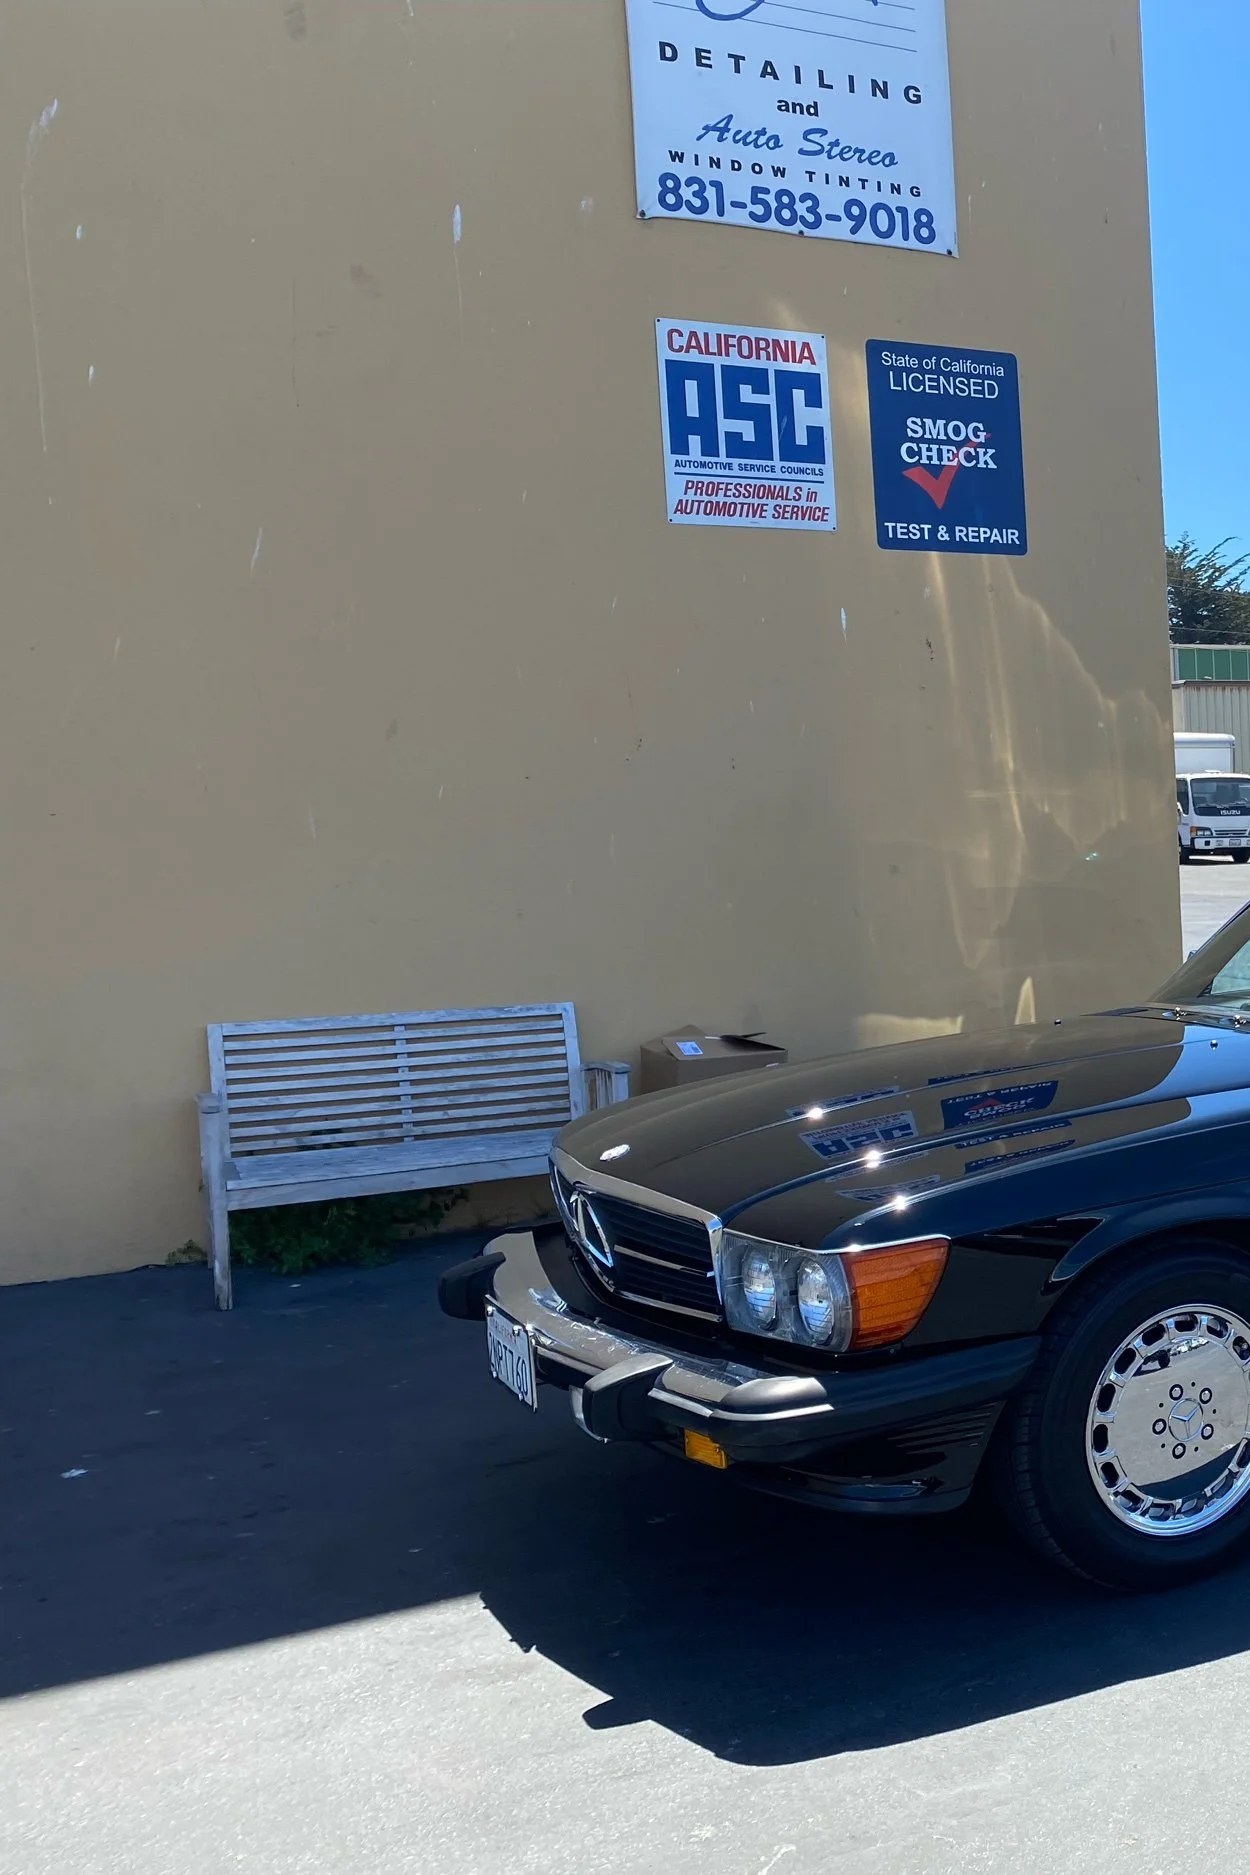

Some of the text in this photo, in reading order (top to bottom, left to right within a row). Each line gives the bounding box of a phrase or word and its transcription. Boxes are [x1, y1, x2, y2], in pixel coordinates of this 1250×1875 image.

[658, 40, 923, 105] DETAILING
[776, 98, 820, 118] and
[695, 113, 899, 168] Auto Stereo
[668, 150, 922, 198] WINDOW TINTING
[657, 171, 937, 245] 831-583-9018
[666, 328, 817, 366] CALIFORNIA
[881, 351, 1005, 377] State of California
[889, 370, 999, 400] LICENSED
[664, 358, 826, 465] ASC
[906, 416, 988, 443] SMOG
[674, 459, 824, 477] AUTOMOTIVE SERVICE COUNCILS
[900, 442, 998, 469] CHECK
[683, 479, 818, 503] PROFESSIONALS in
[673, 498, 831, 523] AUTOMOTIVE SERVICE
[883, 522, 1021, 545] TEST & REPAIR
